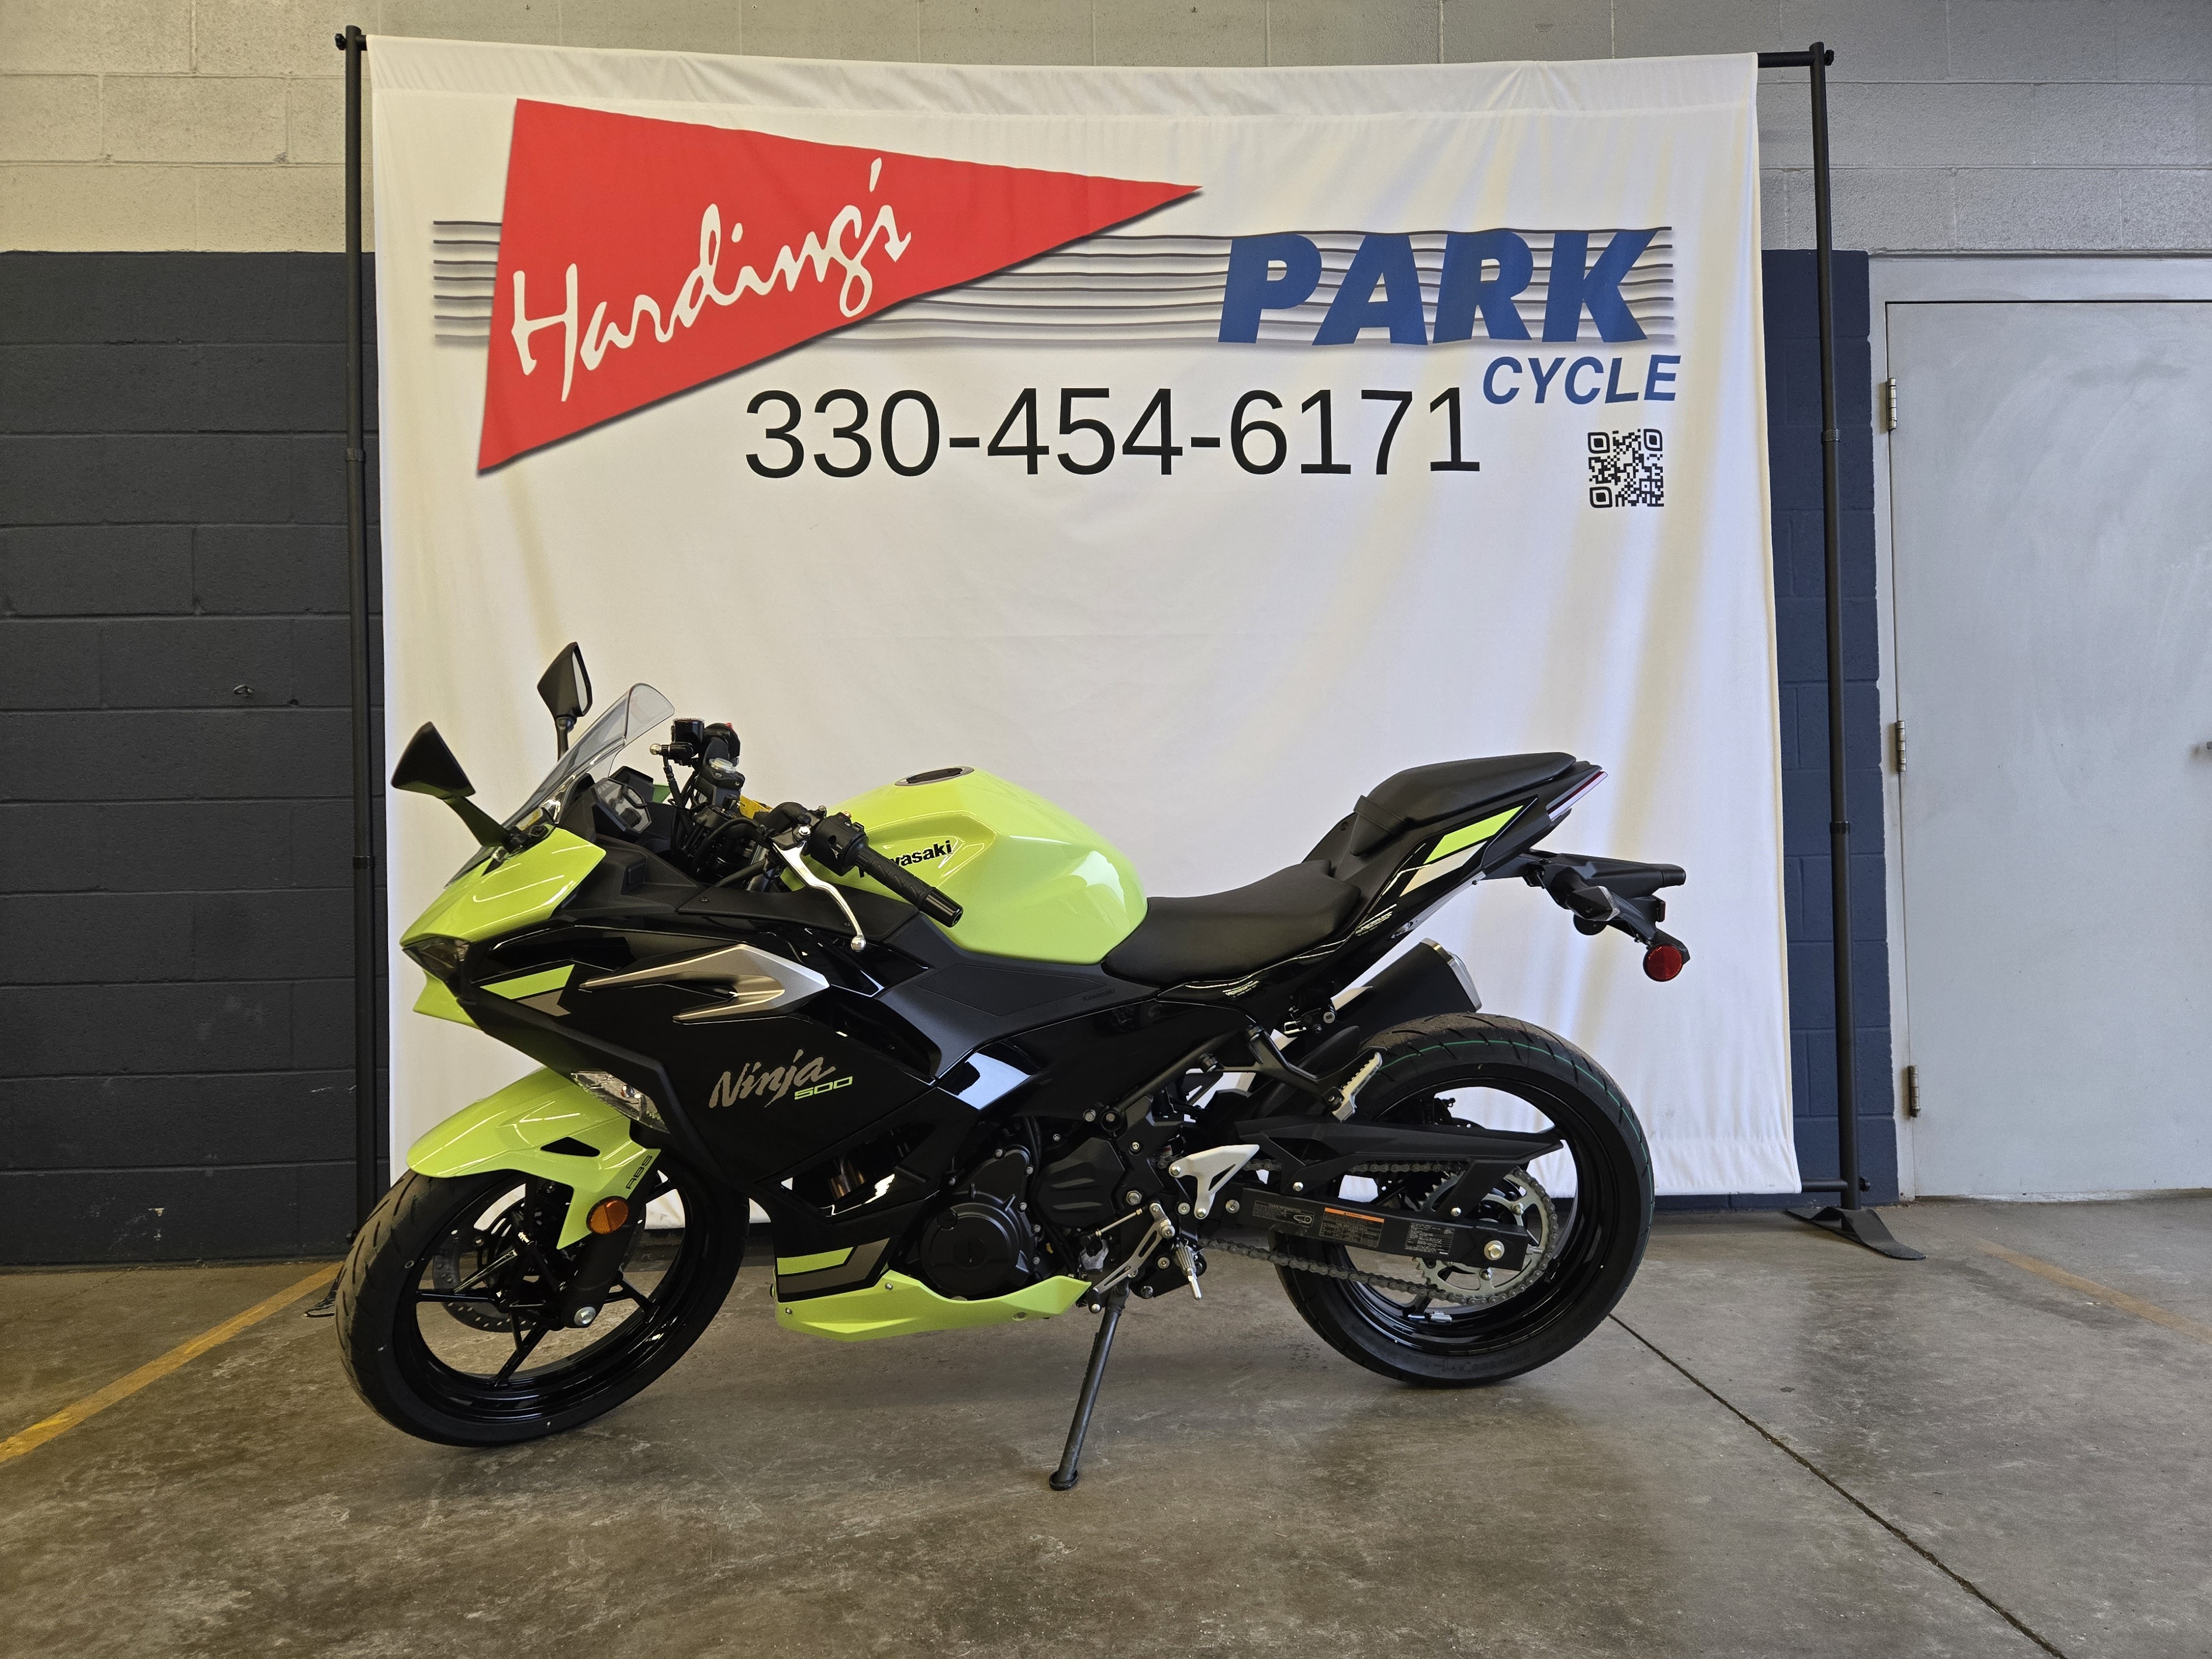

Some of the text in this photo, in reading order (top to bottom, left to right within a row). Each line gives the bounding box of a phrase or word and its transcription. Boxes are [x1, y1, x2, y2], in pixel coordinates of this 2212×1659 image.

[511, 157, 911, 402] Harding's
[1218, 229, 1659, 345] PARK
[1483, 354, 1681, 404] CYCLE
[745, 387, 1480, 478] 330-454-6171
[708, 1048, 836, 1108] Ninja
[794, 1076, 853, 1100] 500
[625, 1155, 653, 1189] ABS
